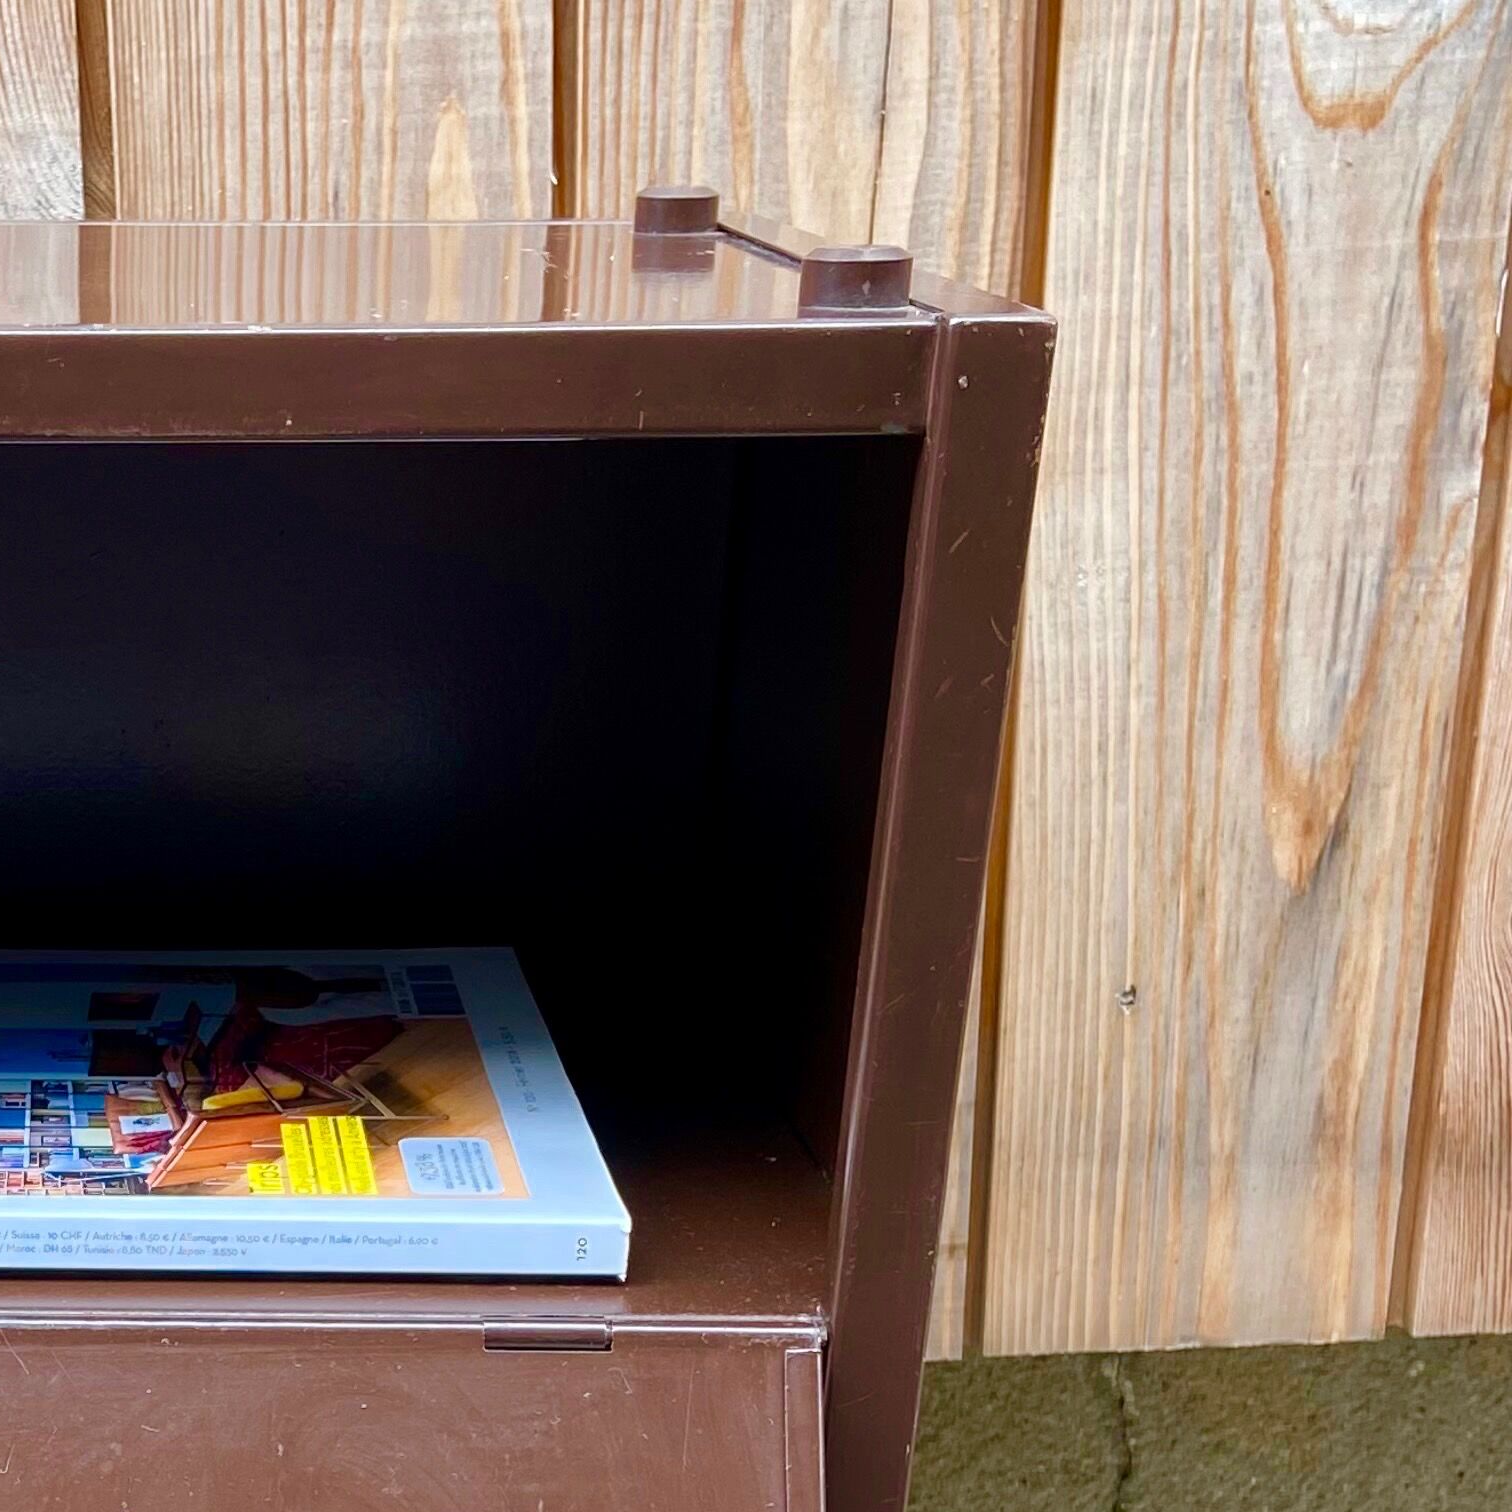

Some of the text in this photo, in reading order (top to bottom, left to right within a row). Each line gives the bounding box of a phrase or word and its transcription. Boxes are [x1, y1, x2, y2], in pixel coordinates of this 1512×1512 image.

[248, 1164, 289, 1193] Trips
[11, 1230, 40, 1239] Suisse
[92, 1231, 133, 1240] Autriche
[279, 1234, 319, 1245] Espagne
[362, 1234, 401, 1247] Portugal
[145, 1246, 167, 1255] TND
[576, 1237, 588, 1262] 120
